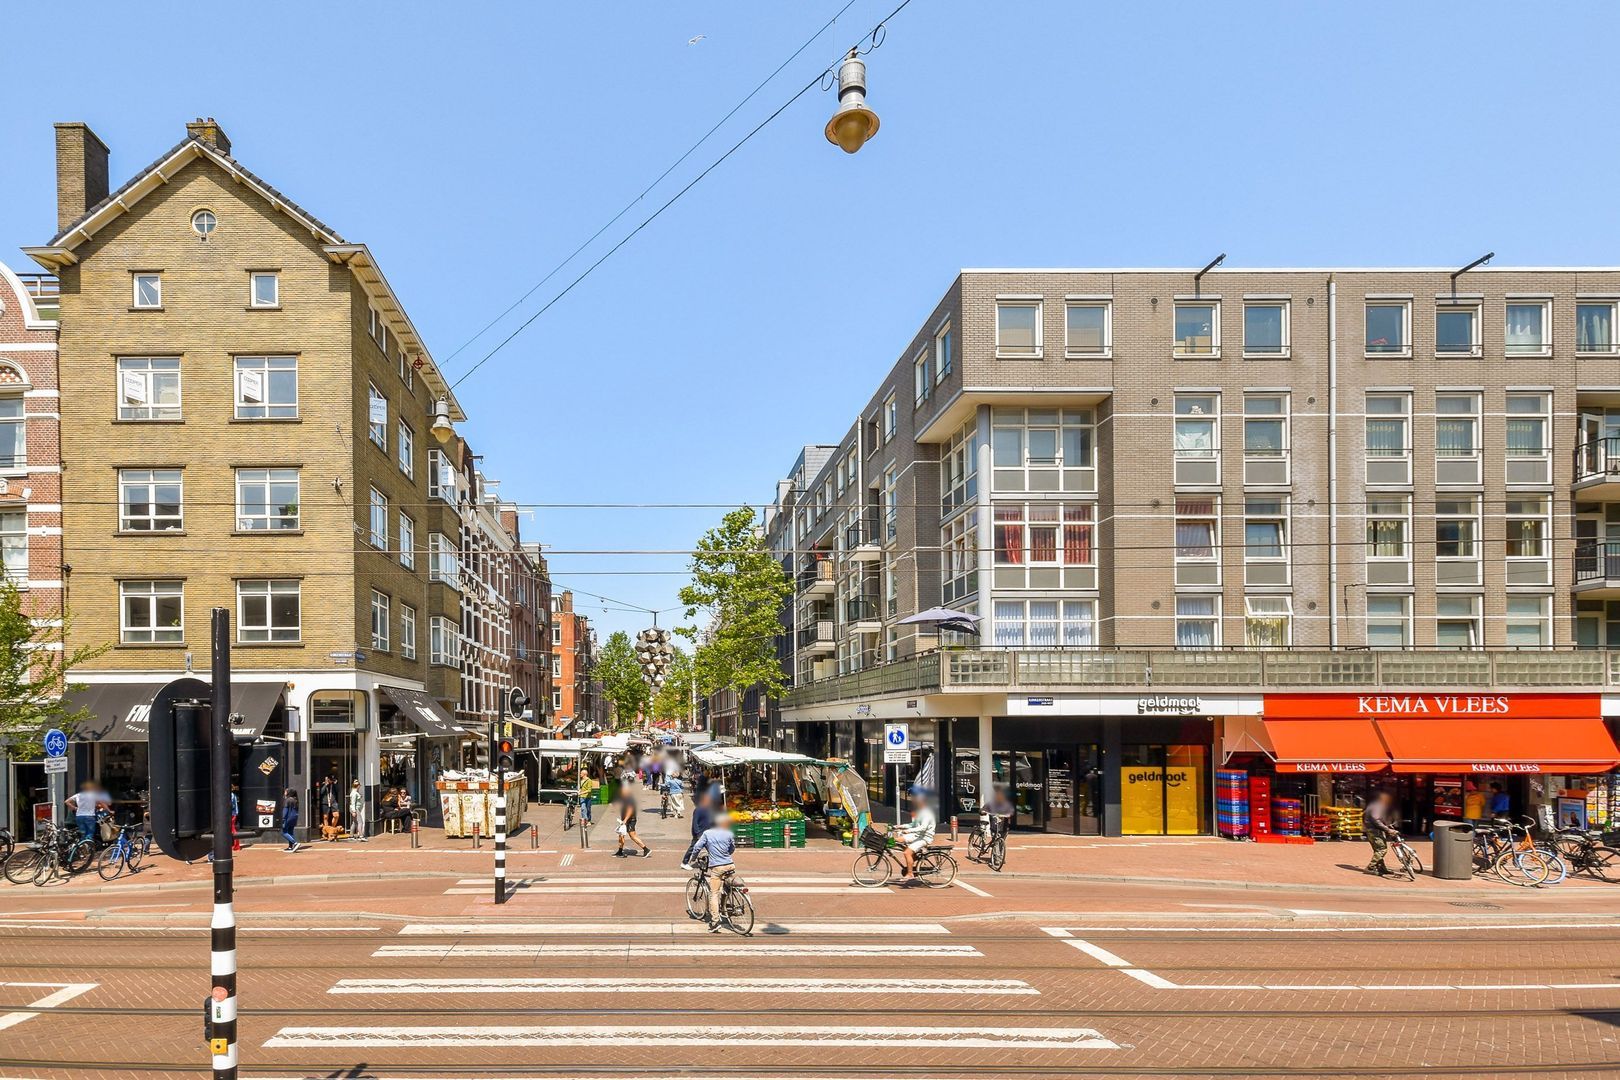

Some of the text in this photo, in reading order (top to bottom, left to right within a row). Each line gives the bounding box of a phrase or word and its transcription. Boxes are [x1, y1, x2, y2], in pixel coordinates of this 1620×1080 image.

[1357, 696, 1509, 713] KEMA VLEES
[1296, 763, 1366, 771] KEMA VLEES
[1471, 763, 1540, 772] KEMA VLEES
